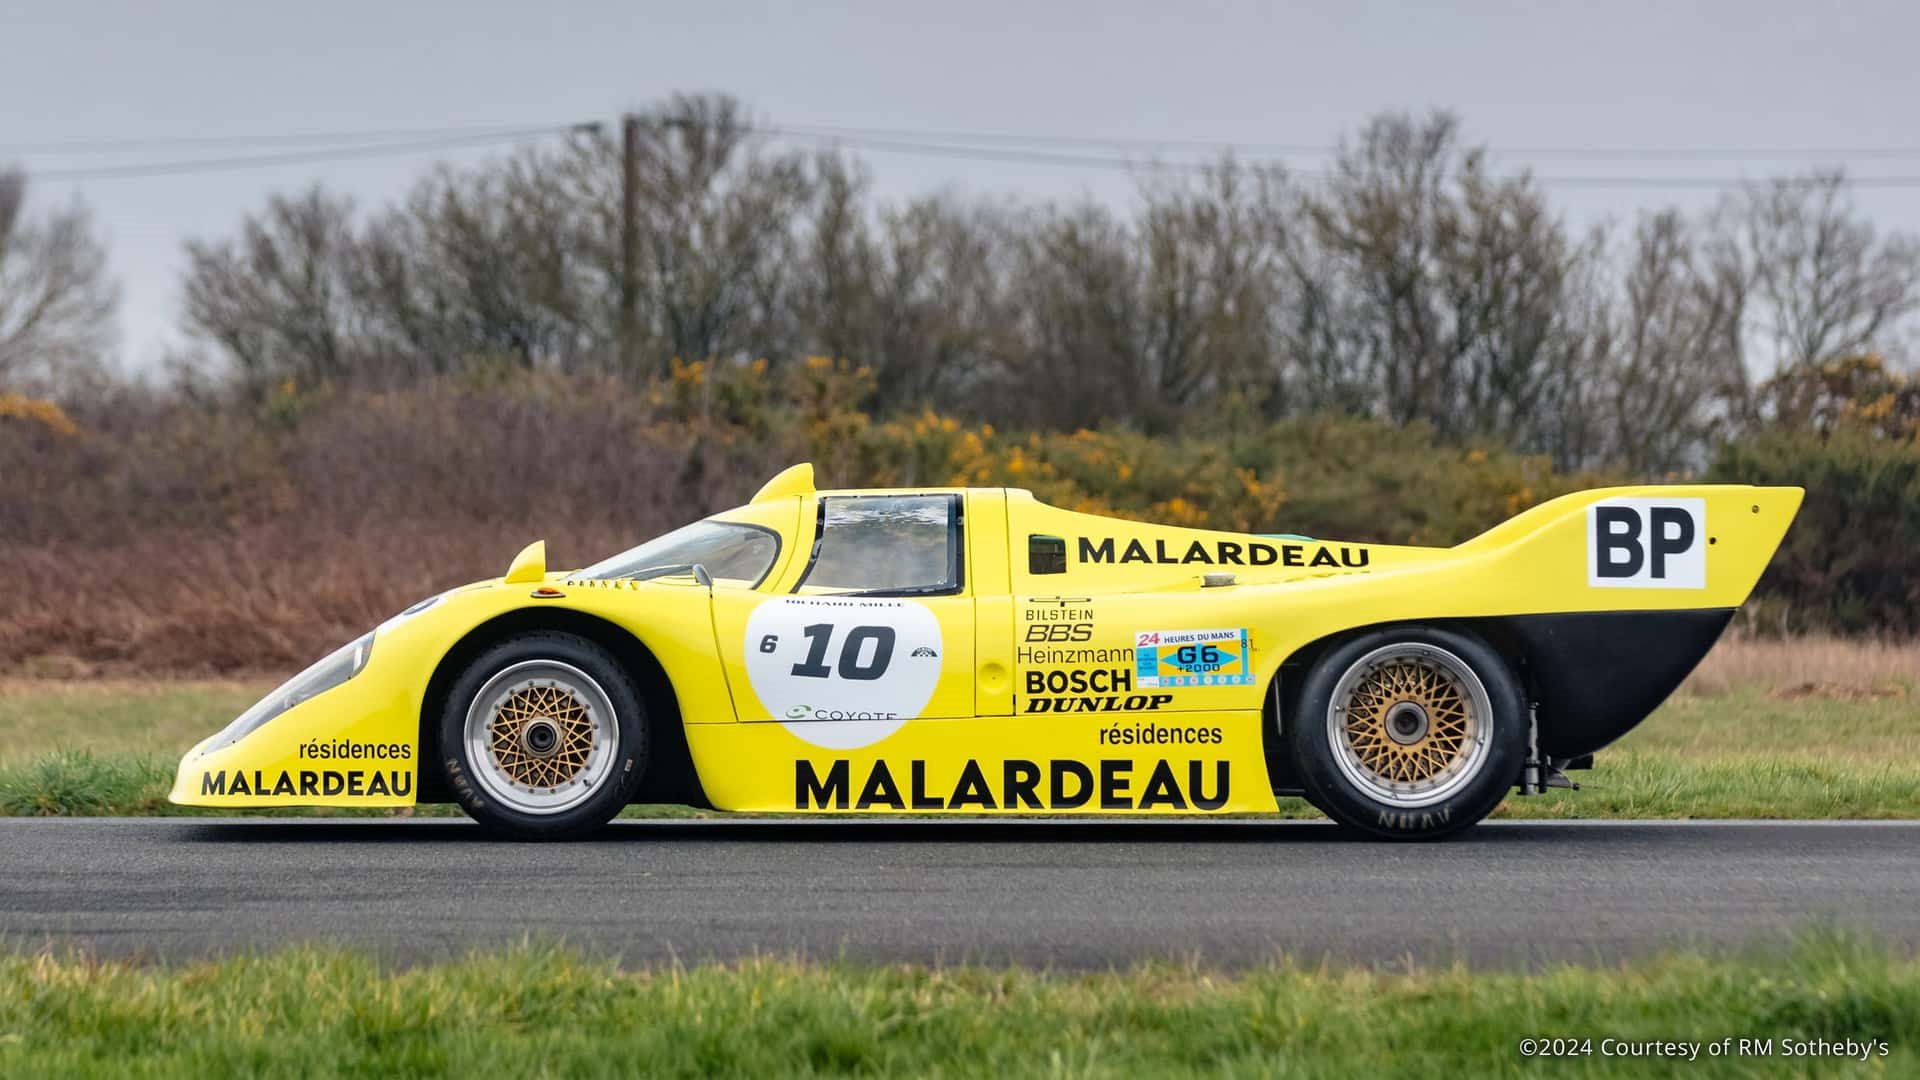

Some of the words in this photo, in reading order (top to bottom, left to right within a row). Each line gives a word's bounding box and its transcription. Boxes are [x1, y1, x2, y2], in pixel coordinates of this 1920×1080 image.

[1078, 537, 1369, 568] MALARDEAU
[1595, 506, 1695, 579] BP
[1026, 609, 1093, 621] BILSTEIN
[1025, 623, 1094, 642] BBS
[1137, 632, 1160, 647] 24
[1164, 635, 1195, 644] HEURES
[1197, 633, 1210, 642] DU
[1211, 631, 1235, 641] MANS
[759, 634, 778, 653] 6
[791, 623, 896, 681] 10
[1018, 646, 1134, 664] Heinzmann
[1177, 645, 1219, 664] G6
[1026, 668, 1131, 694] BOSCH
[1024, 695, 1173, 713] DUNLOP
[1099, 722, 1222, 745] résidences
[299, 738, 411, 759] résidences
[201, 770, 411, 797] MALARDEAU
[795, 759, 1230, 811] MALARDEAU
